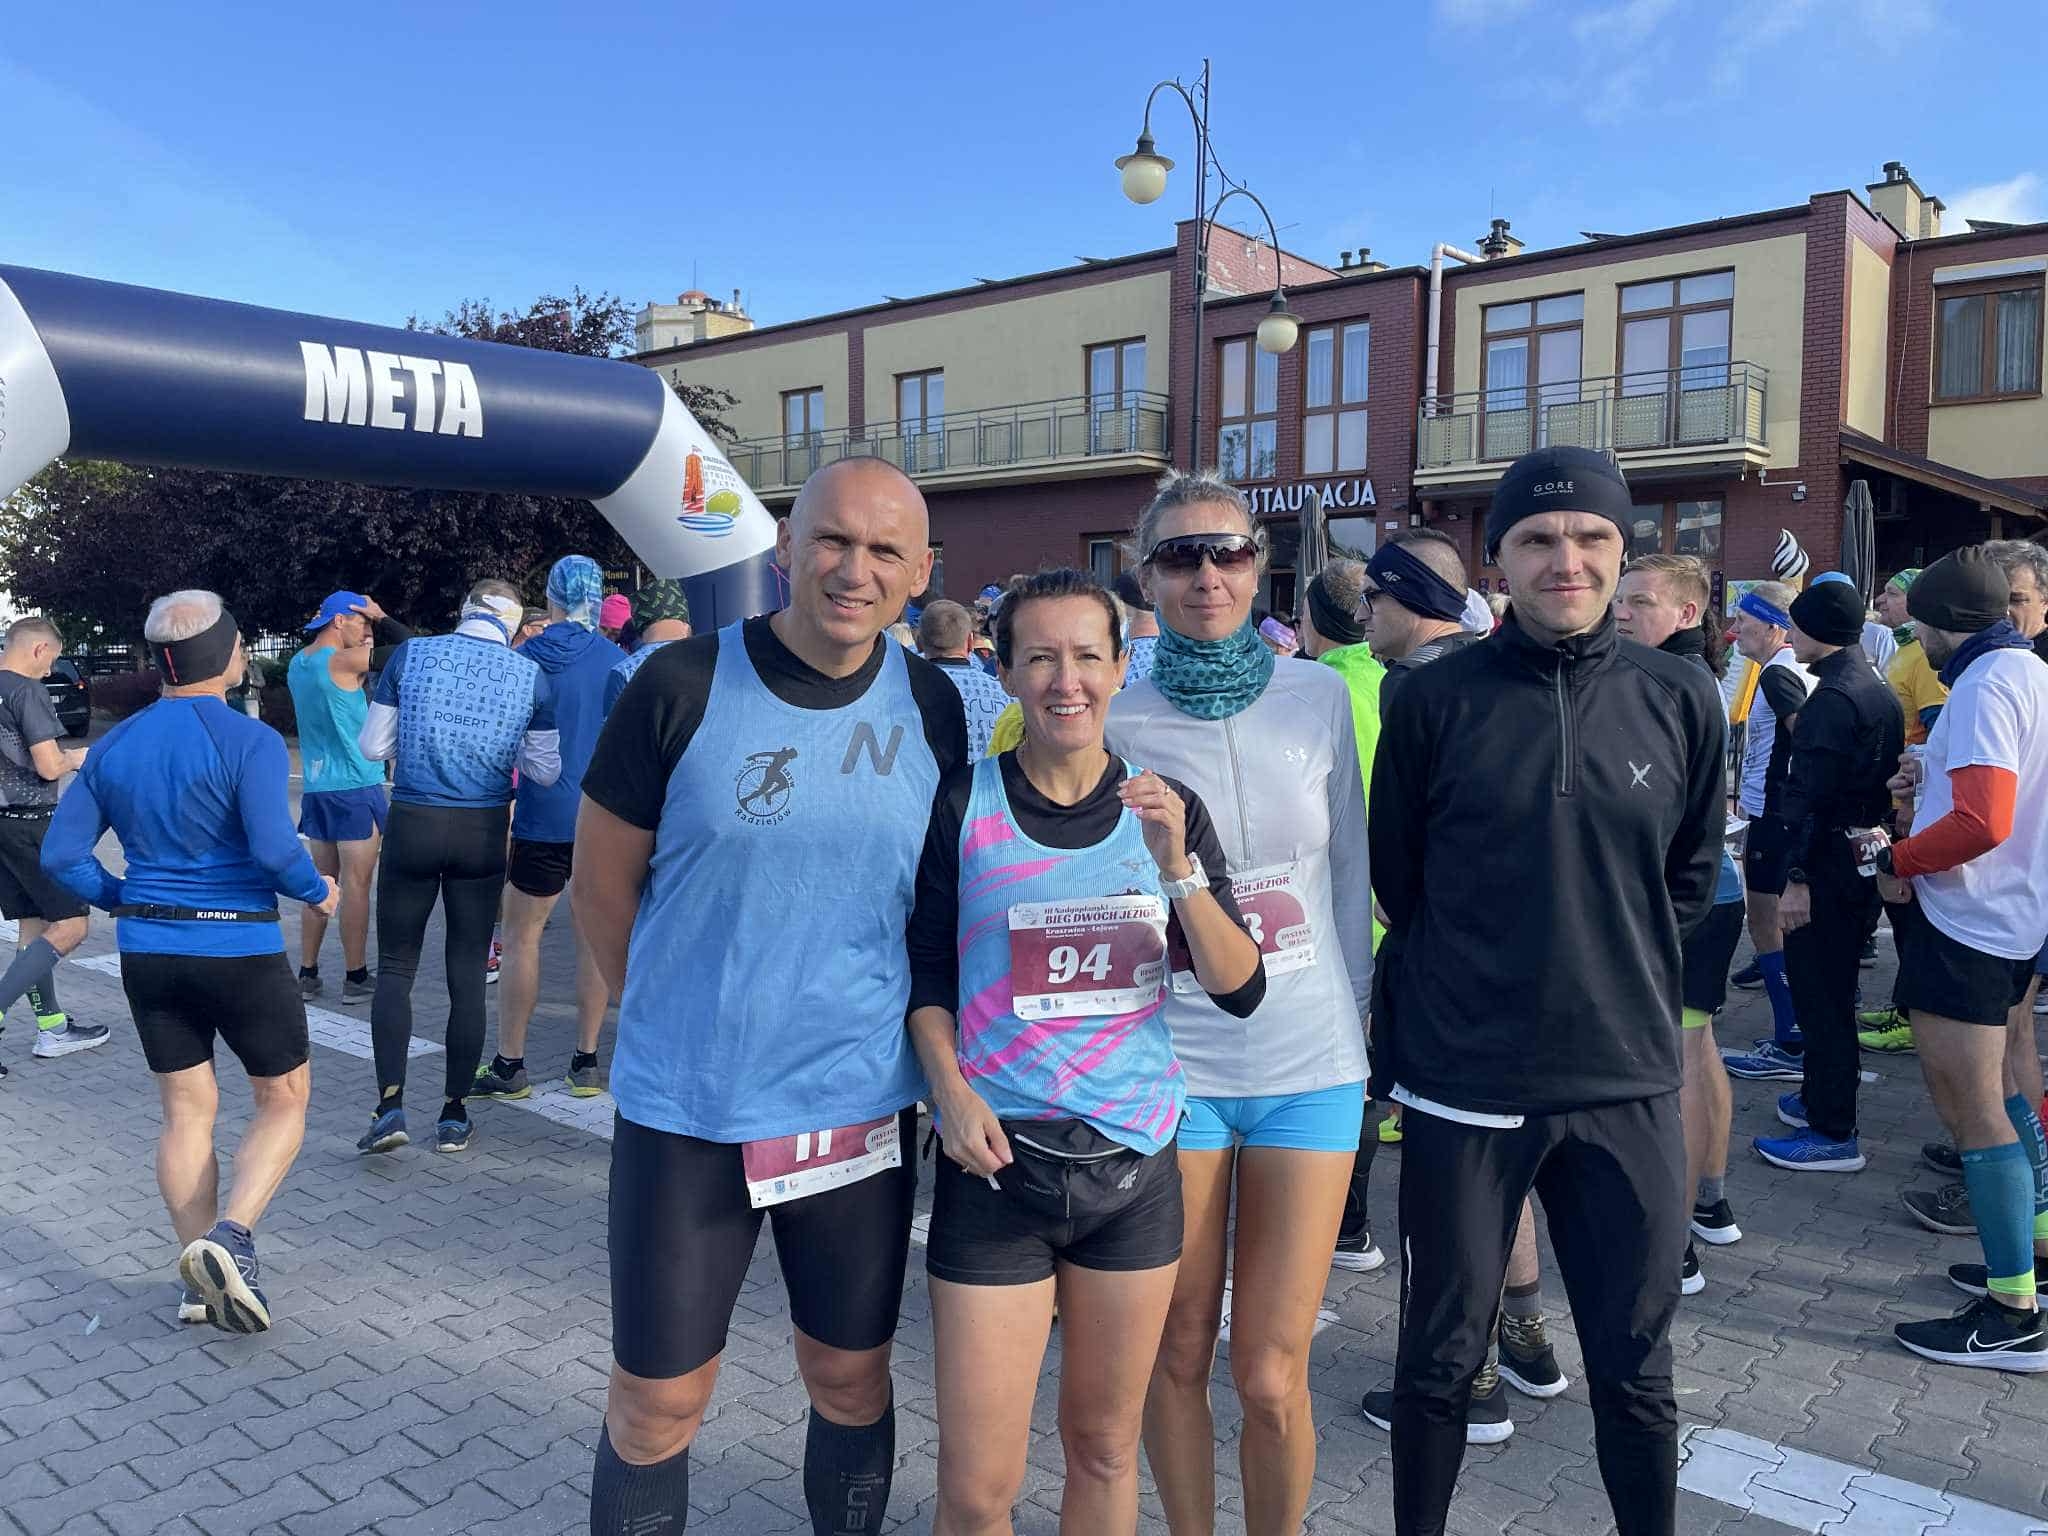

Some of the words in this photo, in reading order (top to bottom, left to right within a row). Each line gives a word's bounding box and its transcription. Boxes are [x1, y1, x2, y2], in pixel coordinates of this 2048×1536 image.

[300, 341, 483, 438] META
[1240, 479, 1377, 514] STAUACJA
[1533, 481, 1575, 493] GORE
[420, 655, 519, 687] parkrun
[433, 711, 489, 729] ROBERT
[735, 807, 792, 826] Radziejów
[1252, 876, 1290, 891] JEZIOR
[196, 911, 238, 920] KIPRUN
[1045, 914, 1071, 924] BIEG
[1047, 943, 1113, 984] 94
[1117, 1168, 1139, 1190] 4F
